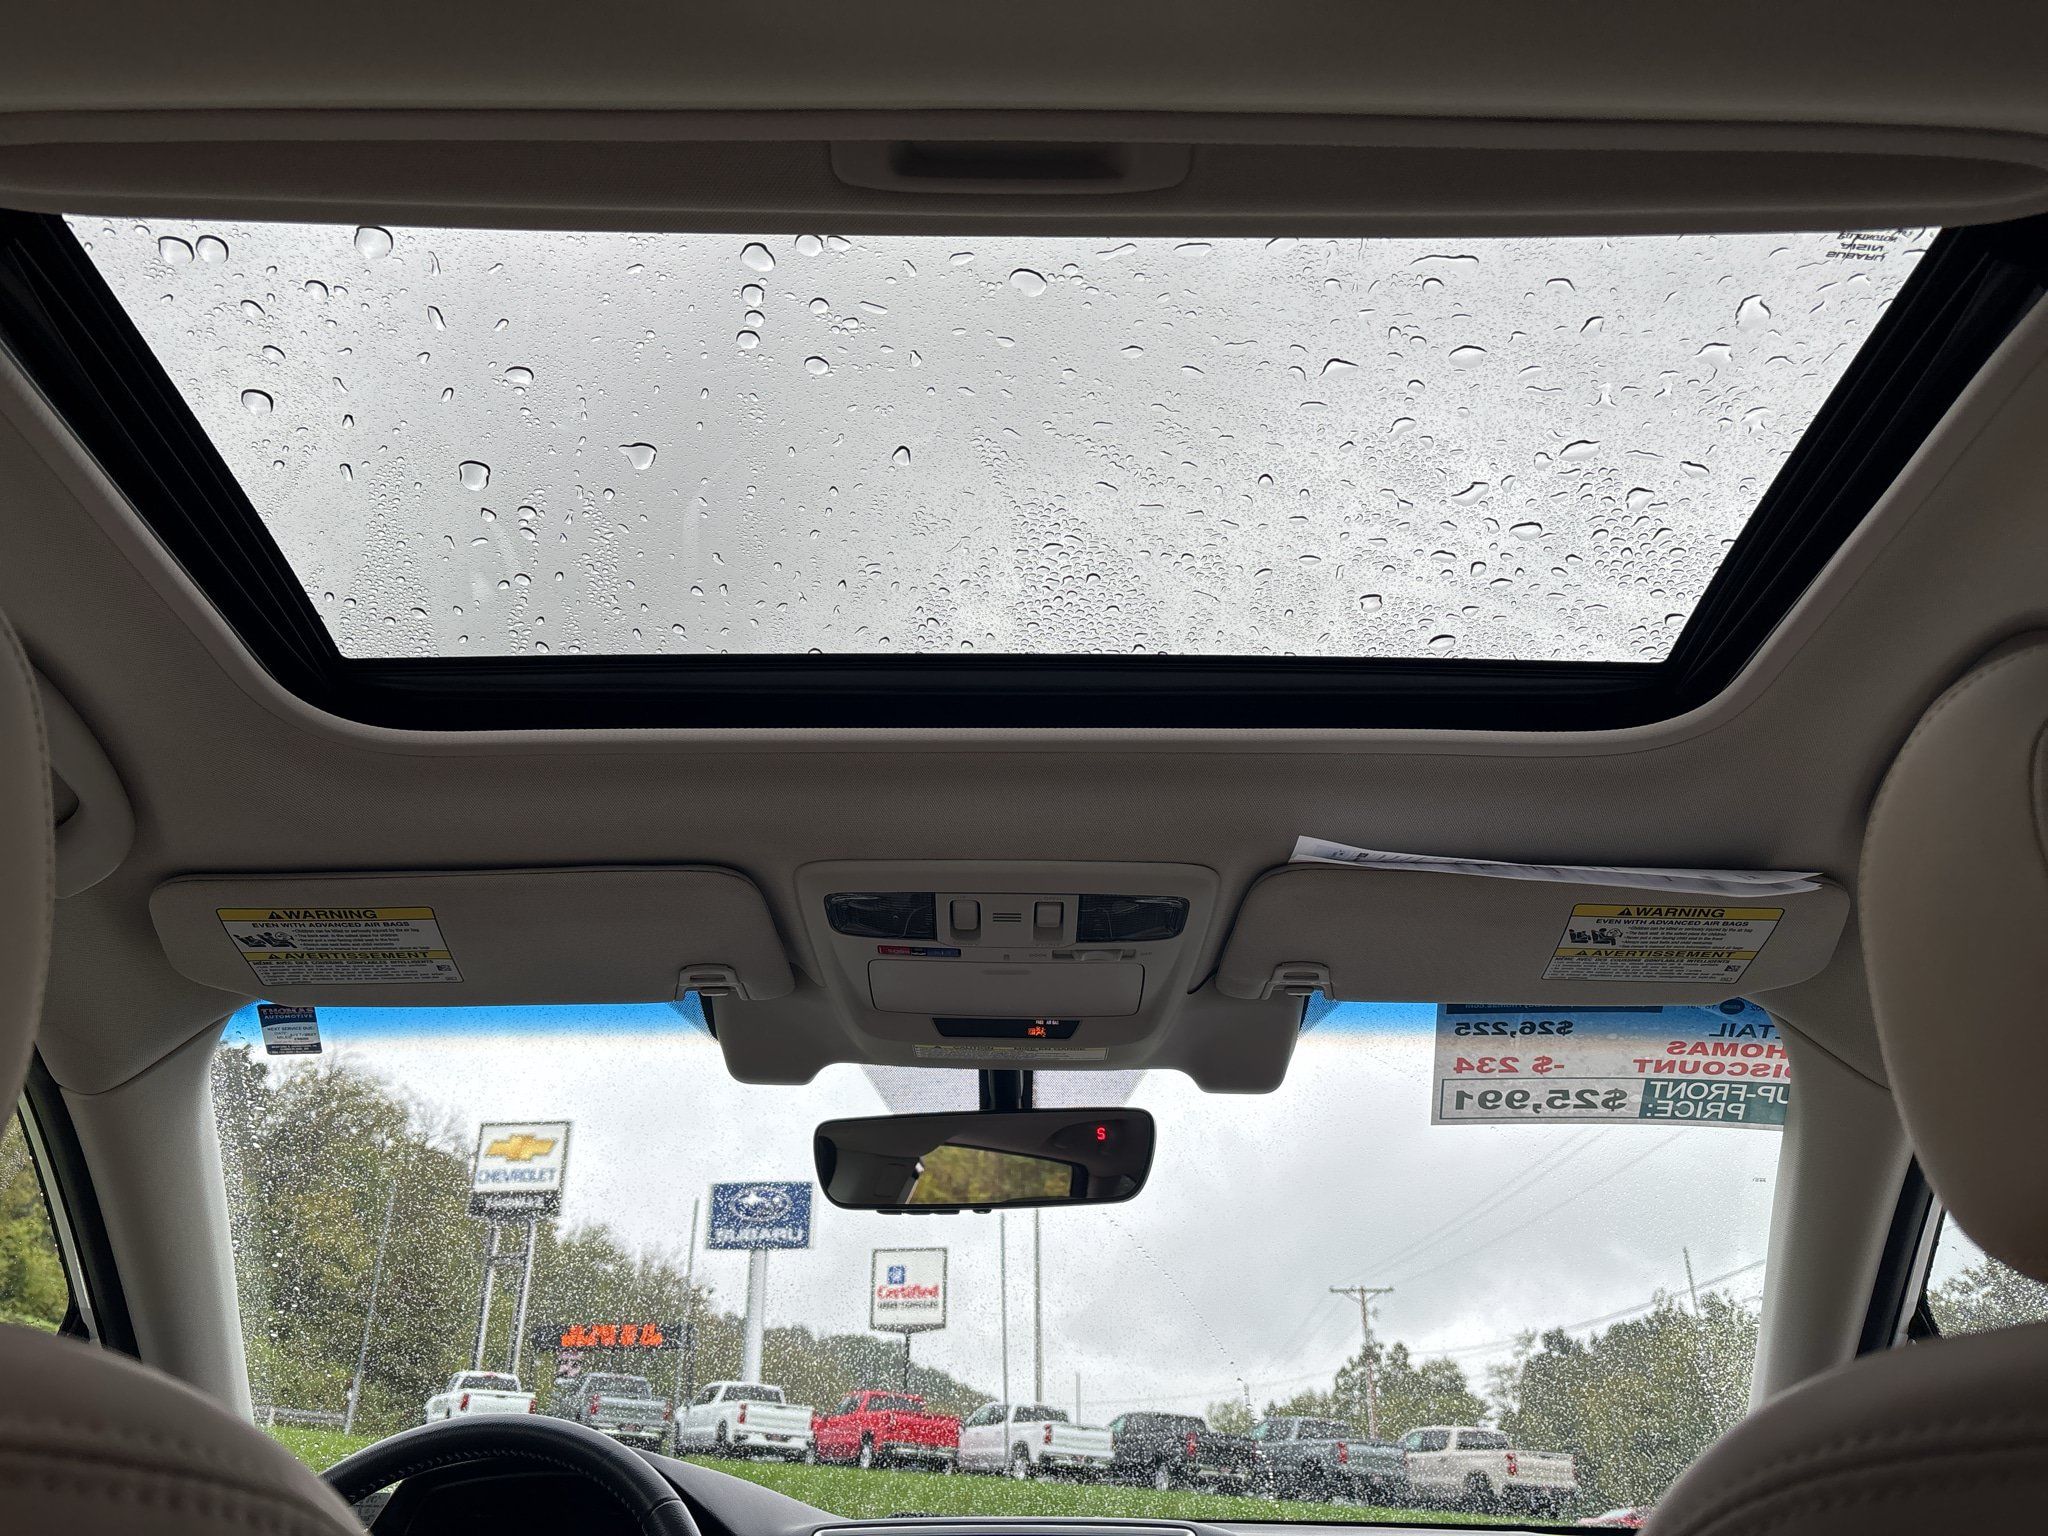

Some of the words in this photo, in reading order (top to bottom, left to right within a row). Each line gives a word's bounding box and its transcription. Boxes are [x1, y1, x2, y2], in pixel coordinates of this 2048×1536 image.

[283, 909, 378, 920] WARNING
[1635, 907, 1726, 918] WARNING
[285, 952, 429, 960] AVERTISSEMENT
[1592, 950, 1735, 958] AVERTISSEMENT
[1096, 1127, 1107, 1141] S
[477, 1168, 557, 1184] CHEVROLET
[877, 1284, 940, 1299] Certified
